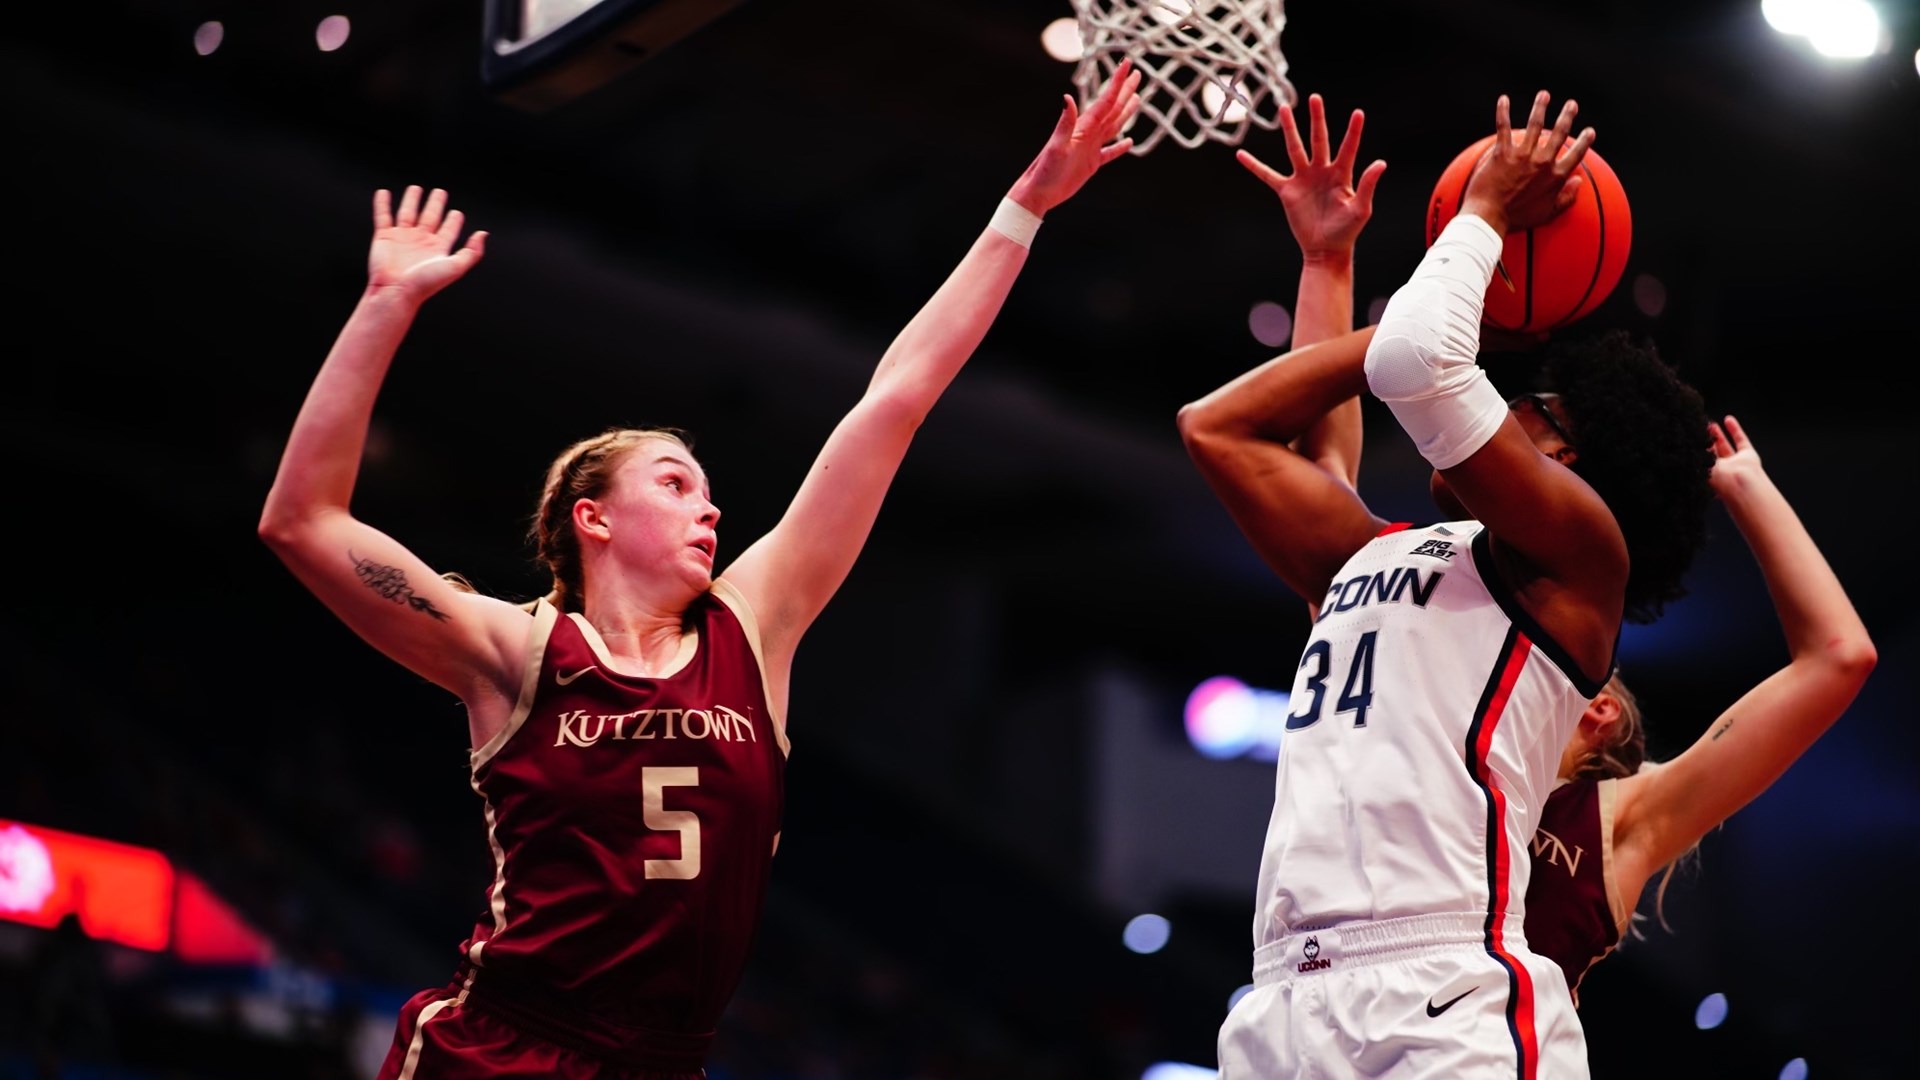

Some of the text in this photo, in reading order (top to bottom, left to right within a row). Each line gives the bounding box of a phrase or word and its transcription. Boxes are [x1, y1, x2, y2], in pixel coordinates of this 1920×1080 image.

[1414, 547, 1457, 558] EAST
[1423, 540, 1453, 549] BIG
[1285, 629, 1379, 733] 34
[553, 704, 757, 748] KUTZTOWN
[642, 766, 701, 880] 5
[1298, 959, 1331, 973] UCONN
